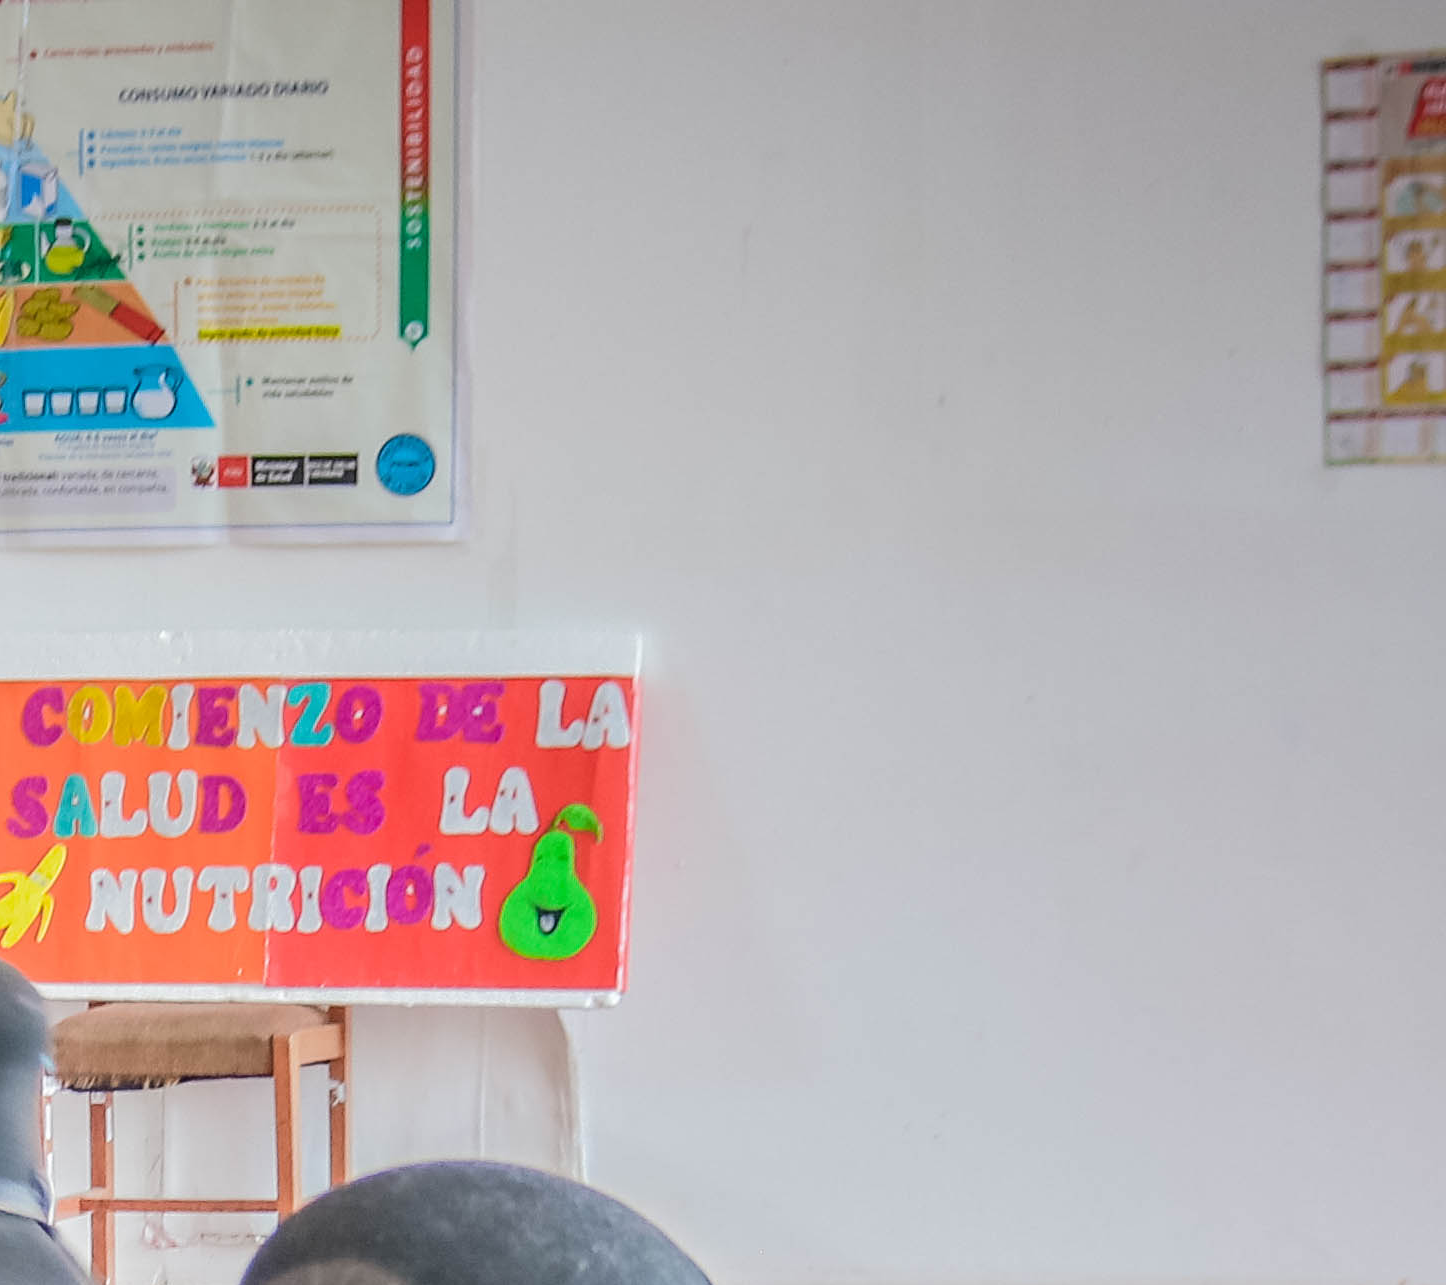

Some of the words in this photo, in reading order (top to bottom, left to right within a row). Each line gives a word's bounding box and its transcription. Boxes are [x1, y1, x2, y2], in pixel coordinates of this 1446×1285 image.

[118, 86, 199, 103] CONSUMO
[201, 82, 271, 100] VARIADO
[273, 79, 330, 98] DIARIO
[405, 46, 424, 250] SOSTENIBILIDAD
[21, 682, 384, 751] COMIENZO
[414, 681, 506, 744] DE
[535, 679, 632, 751] LA
[5, 768, 248, 839] SALUD
[296, 769, 386, 835] ES
[438, 765, 540, 836] LA
[84, 843, 486, 935] NUTRICIÓN
